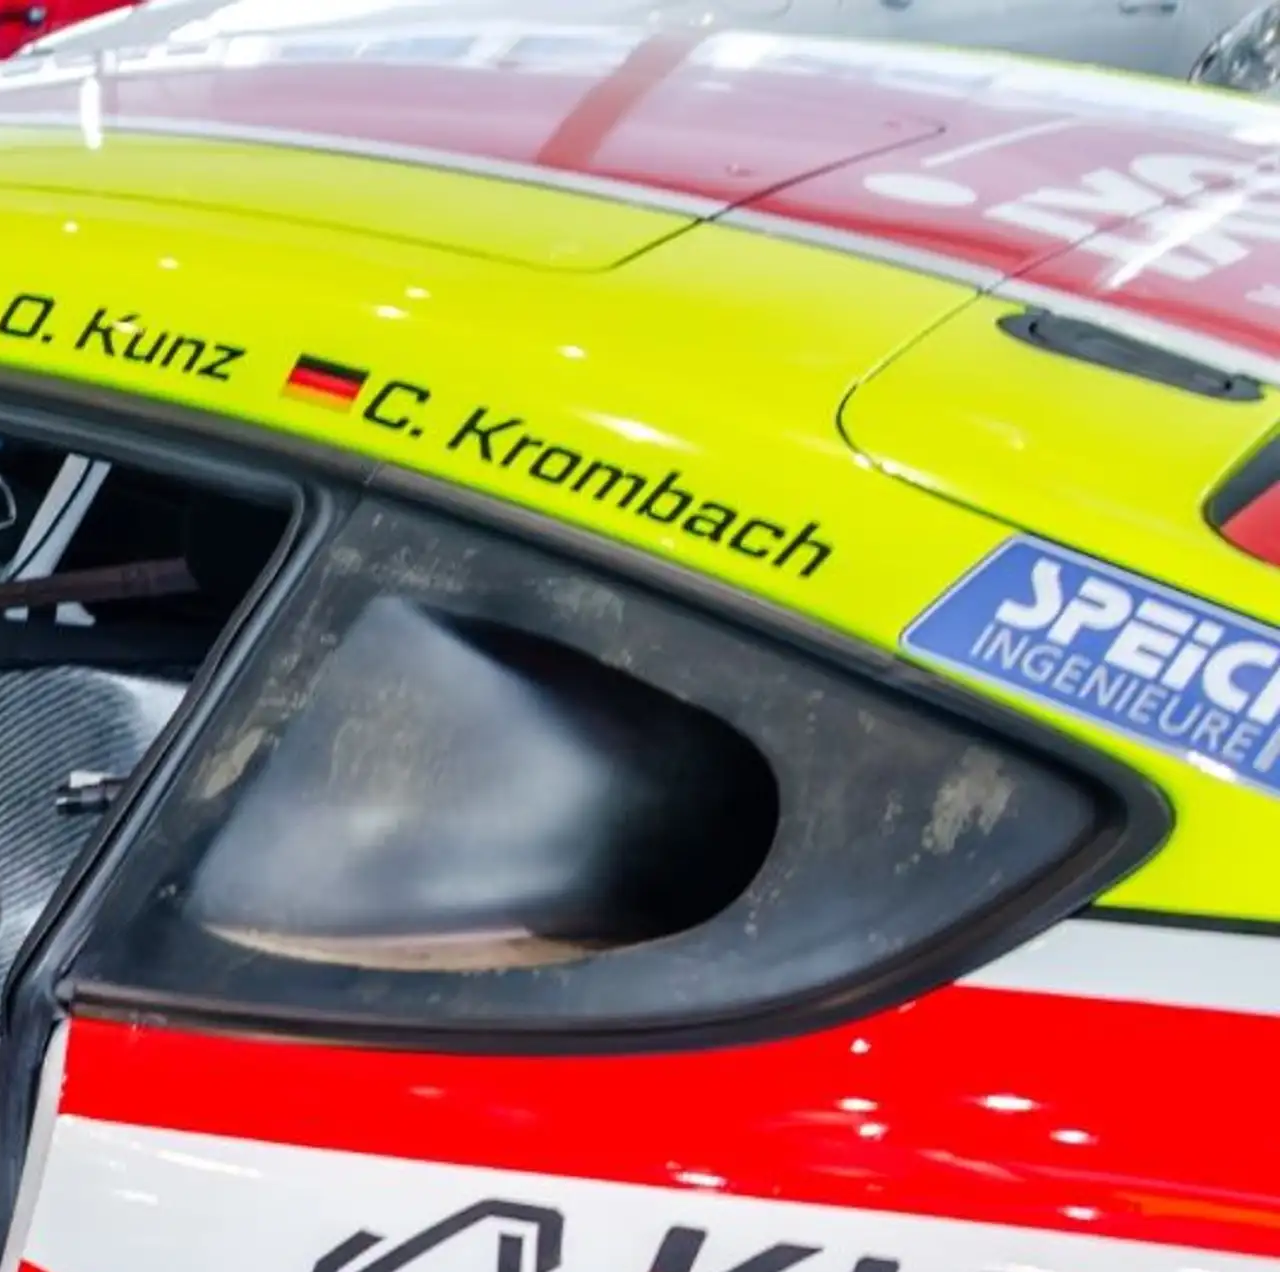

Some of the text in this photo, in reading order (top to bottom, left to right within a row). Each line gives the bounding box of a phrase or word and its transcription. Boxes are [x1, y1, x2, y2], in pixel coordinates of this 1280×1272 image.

[74, 307, 247, 383] Kunz
[362, 379, 834, 580] C. Krombach
